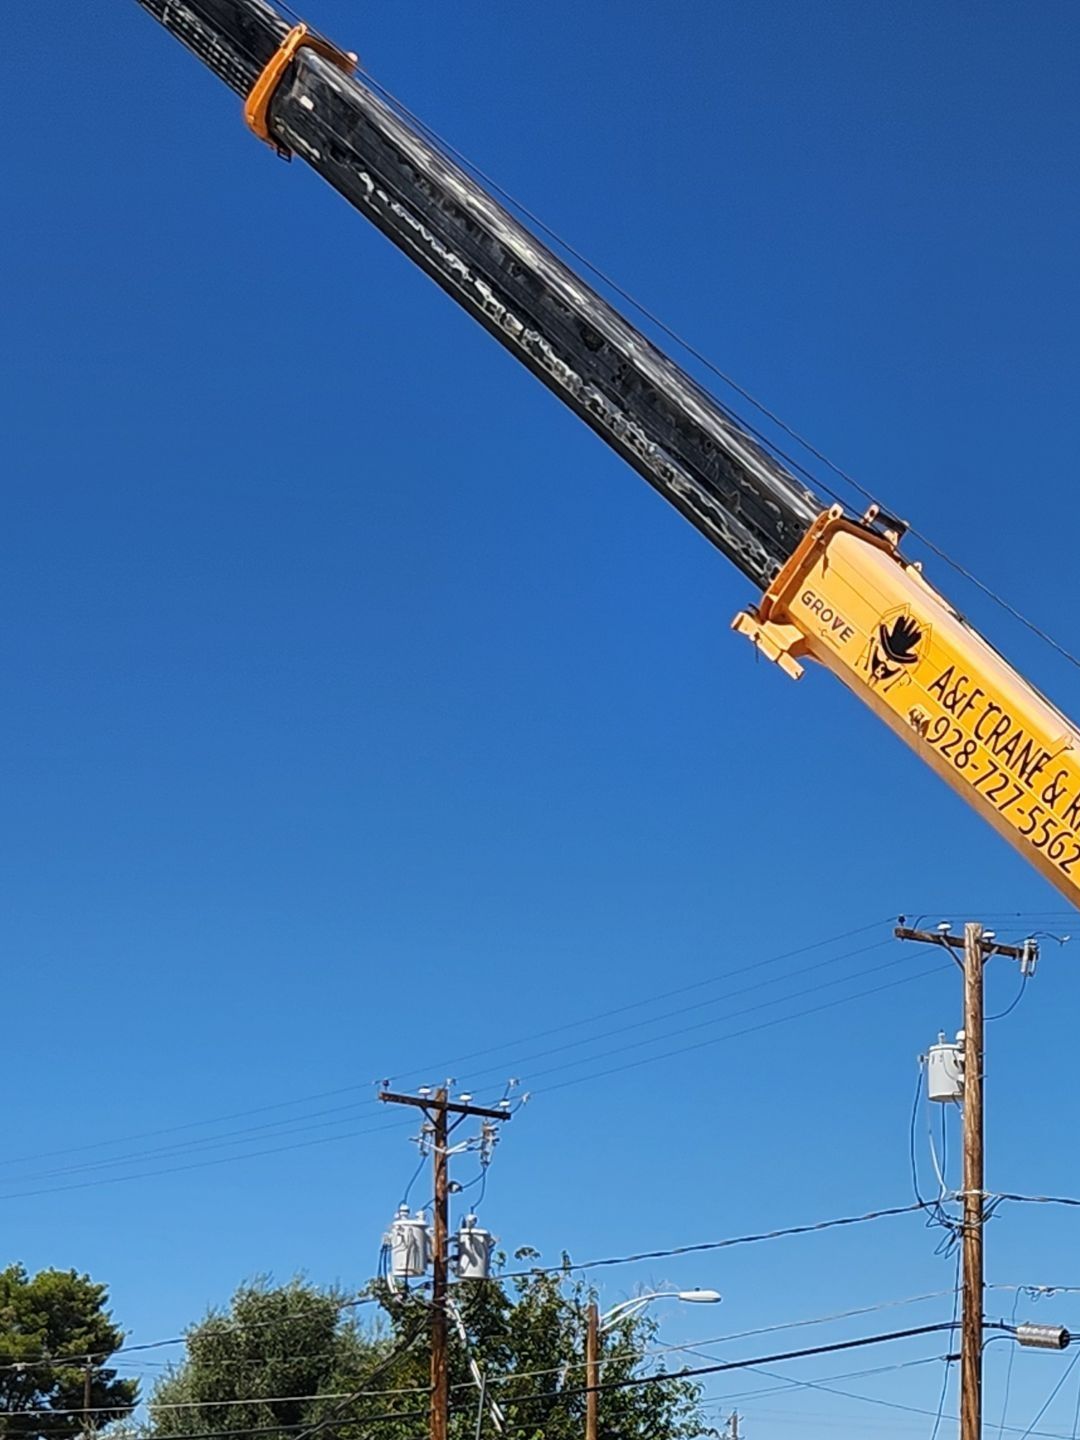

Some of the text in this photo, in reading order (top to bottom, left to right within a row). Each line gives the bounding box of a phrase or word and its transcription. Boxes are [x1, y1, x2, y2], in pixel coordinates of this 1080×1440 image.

[801, 590, 855, 643] GROVE
[927, 665, 985, 720] A&F
[974, 702, 1051, 788] CRANE
[1041, 770, 1069, 809] &
